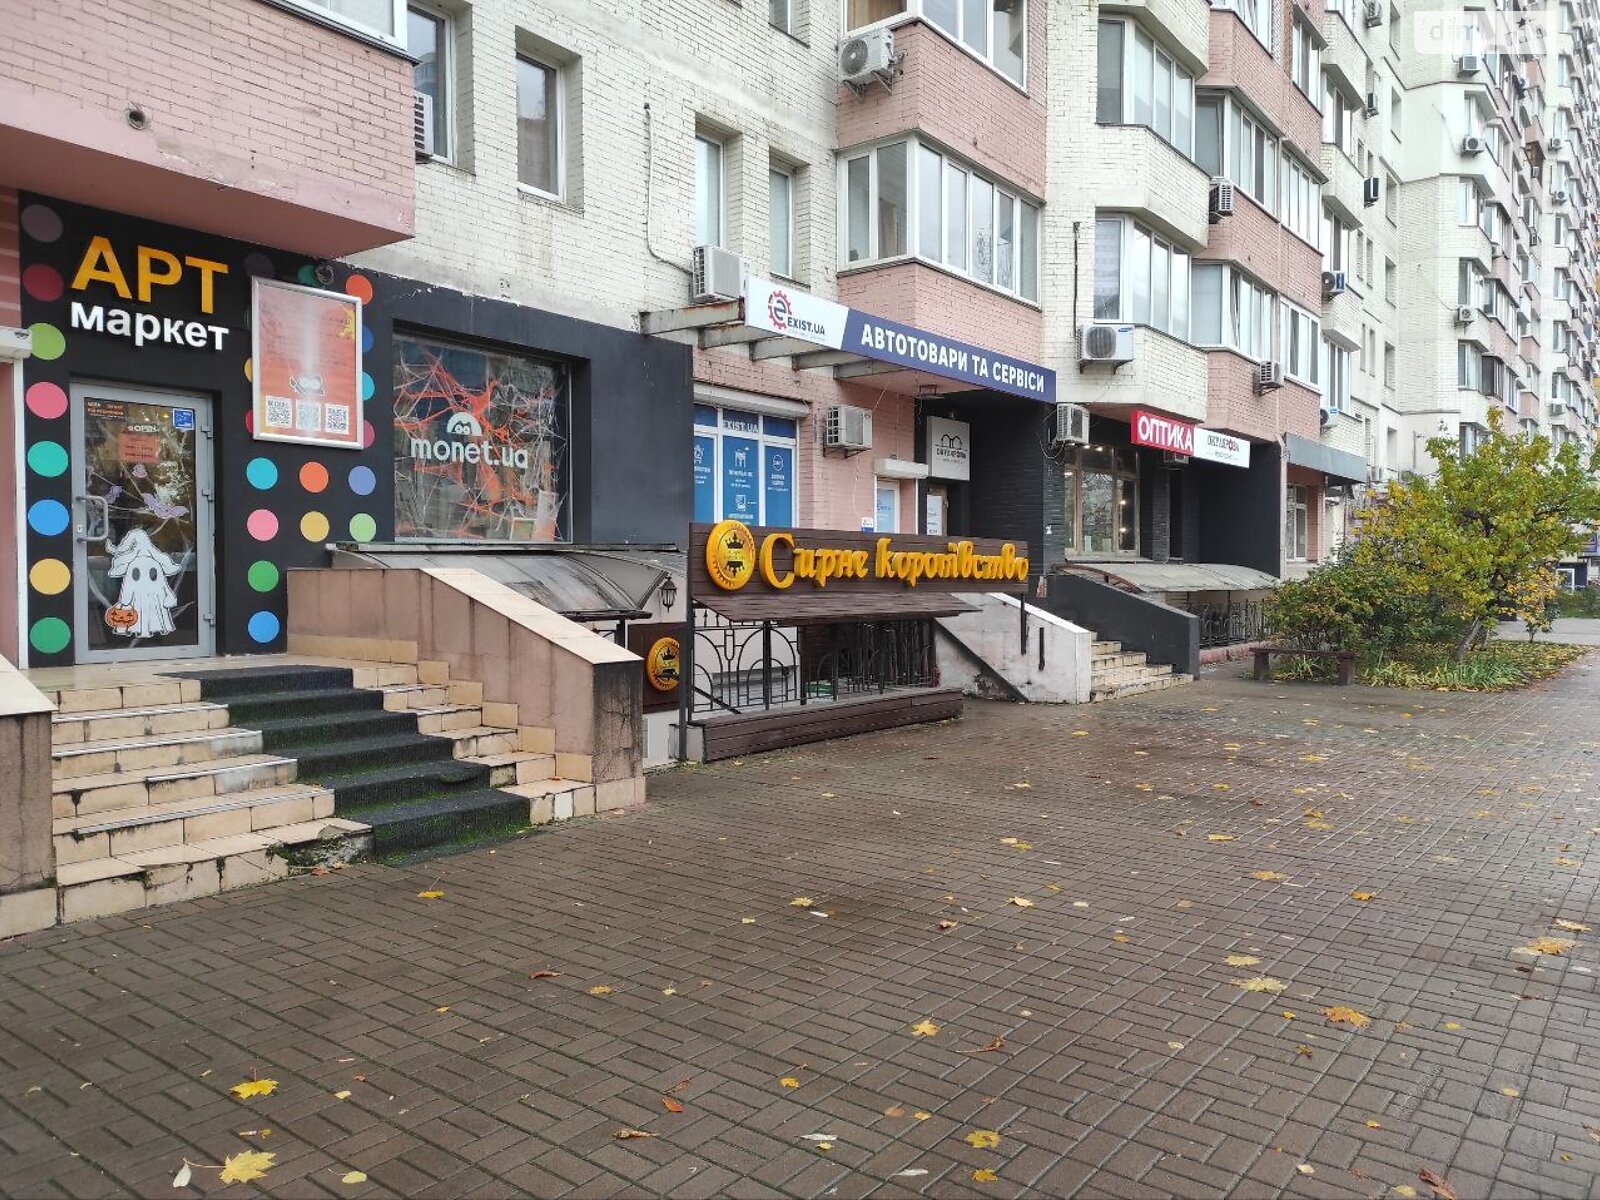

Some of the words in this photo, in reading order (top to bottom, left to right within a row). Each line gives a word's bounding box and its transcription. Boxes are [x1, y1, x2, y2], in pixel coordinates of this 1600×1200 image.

[71, 235, 229, 314] АРТ
[71, 302, 229, 350] маркет
[787, 316, 826, 336] EXIST.UA
[860, 323, 968, 373] АВТОТОВАРИ
[971, 355, 989, 379] ТА
[992, 361, 1045, 394] СЕРВІСИ
[410, 438, 529, 470] monet.ua
[1137, 415, 1194, 453] ОПТИКА
[759, 532, 869, 590] Сирне
